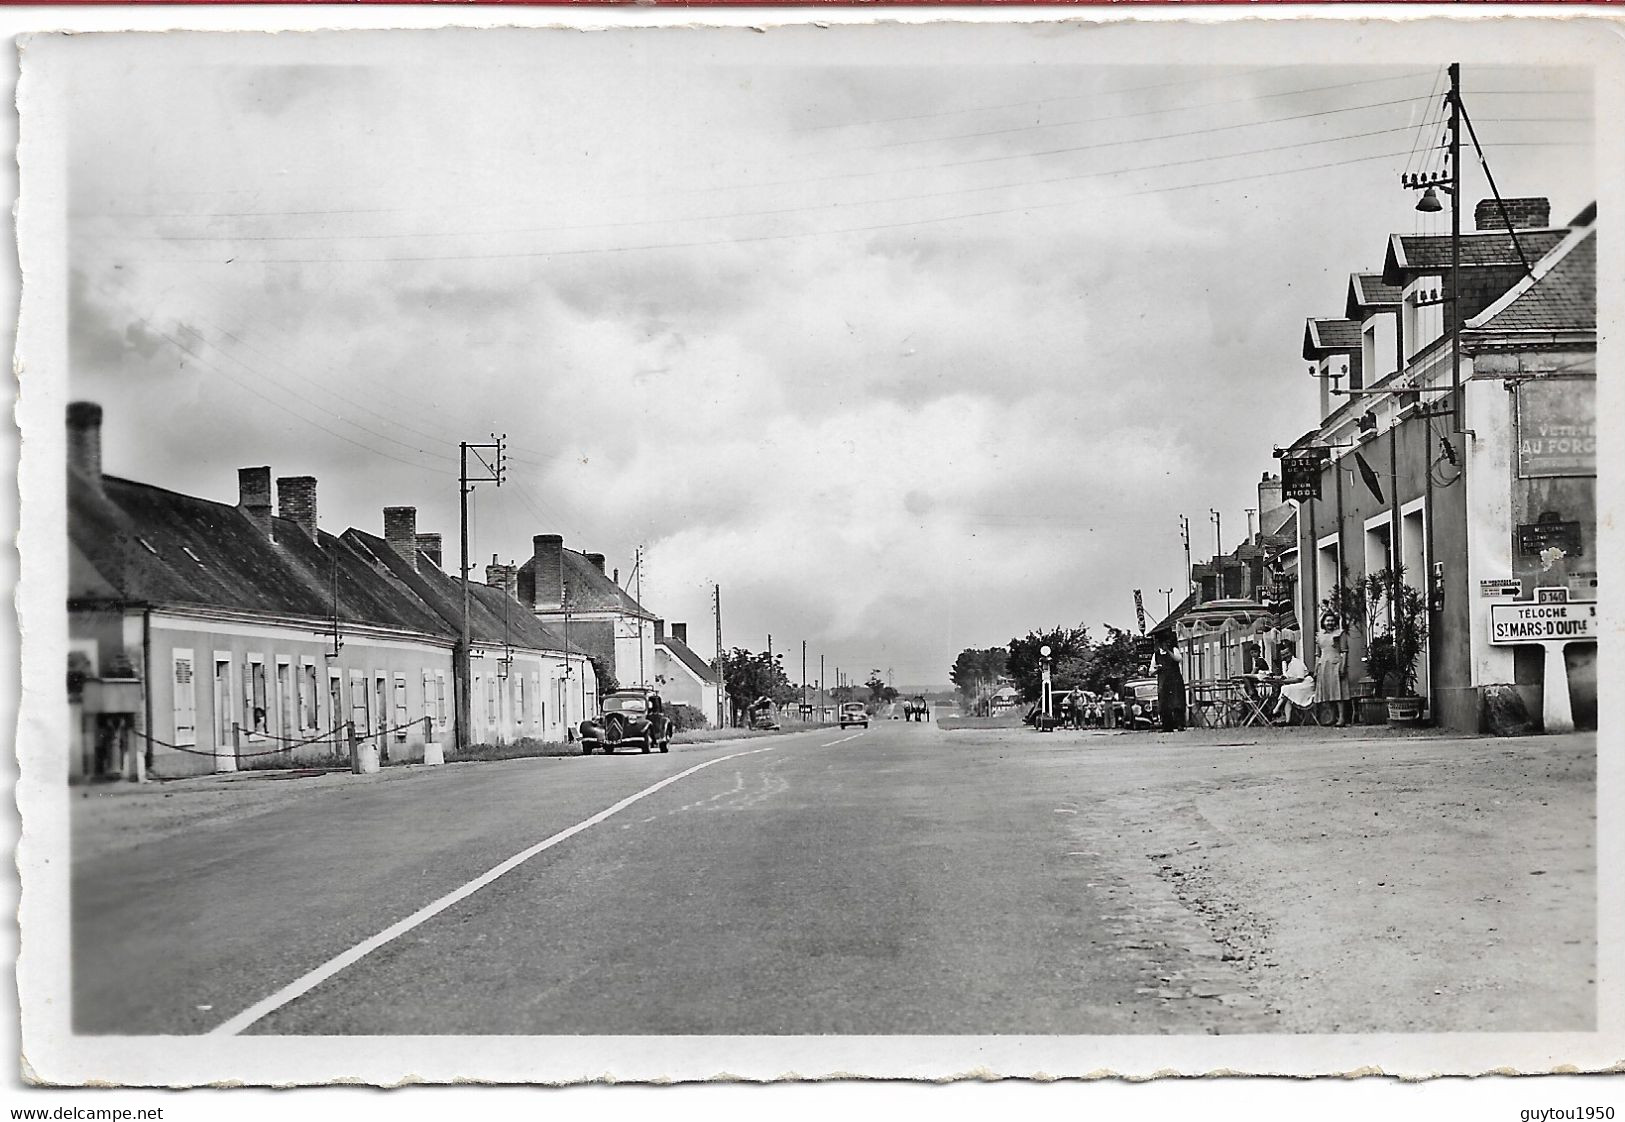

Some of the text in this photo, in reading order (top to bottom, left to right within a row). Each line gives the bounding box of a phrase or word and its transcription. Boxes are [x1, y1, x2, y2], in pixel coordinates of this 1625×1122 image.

[1521, 440, 1542, 454] AU
[1541, 592, 1564, 602] D 140
